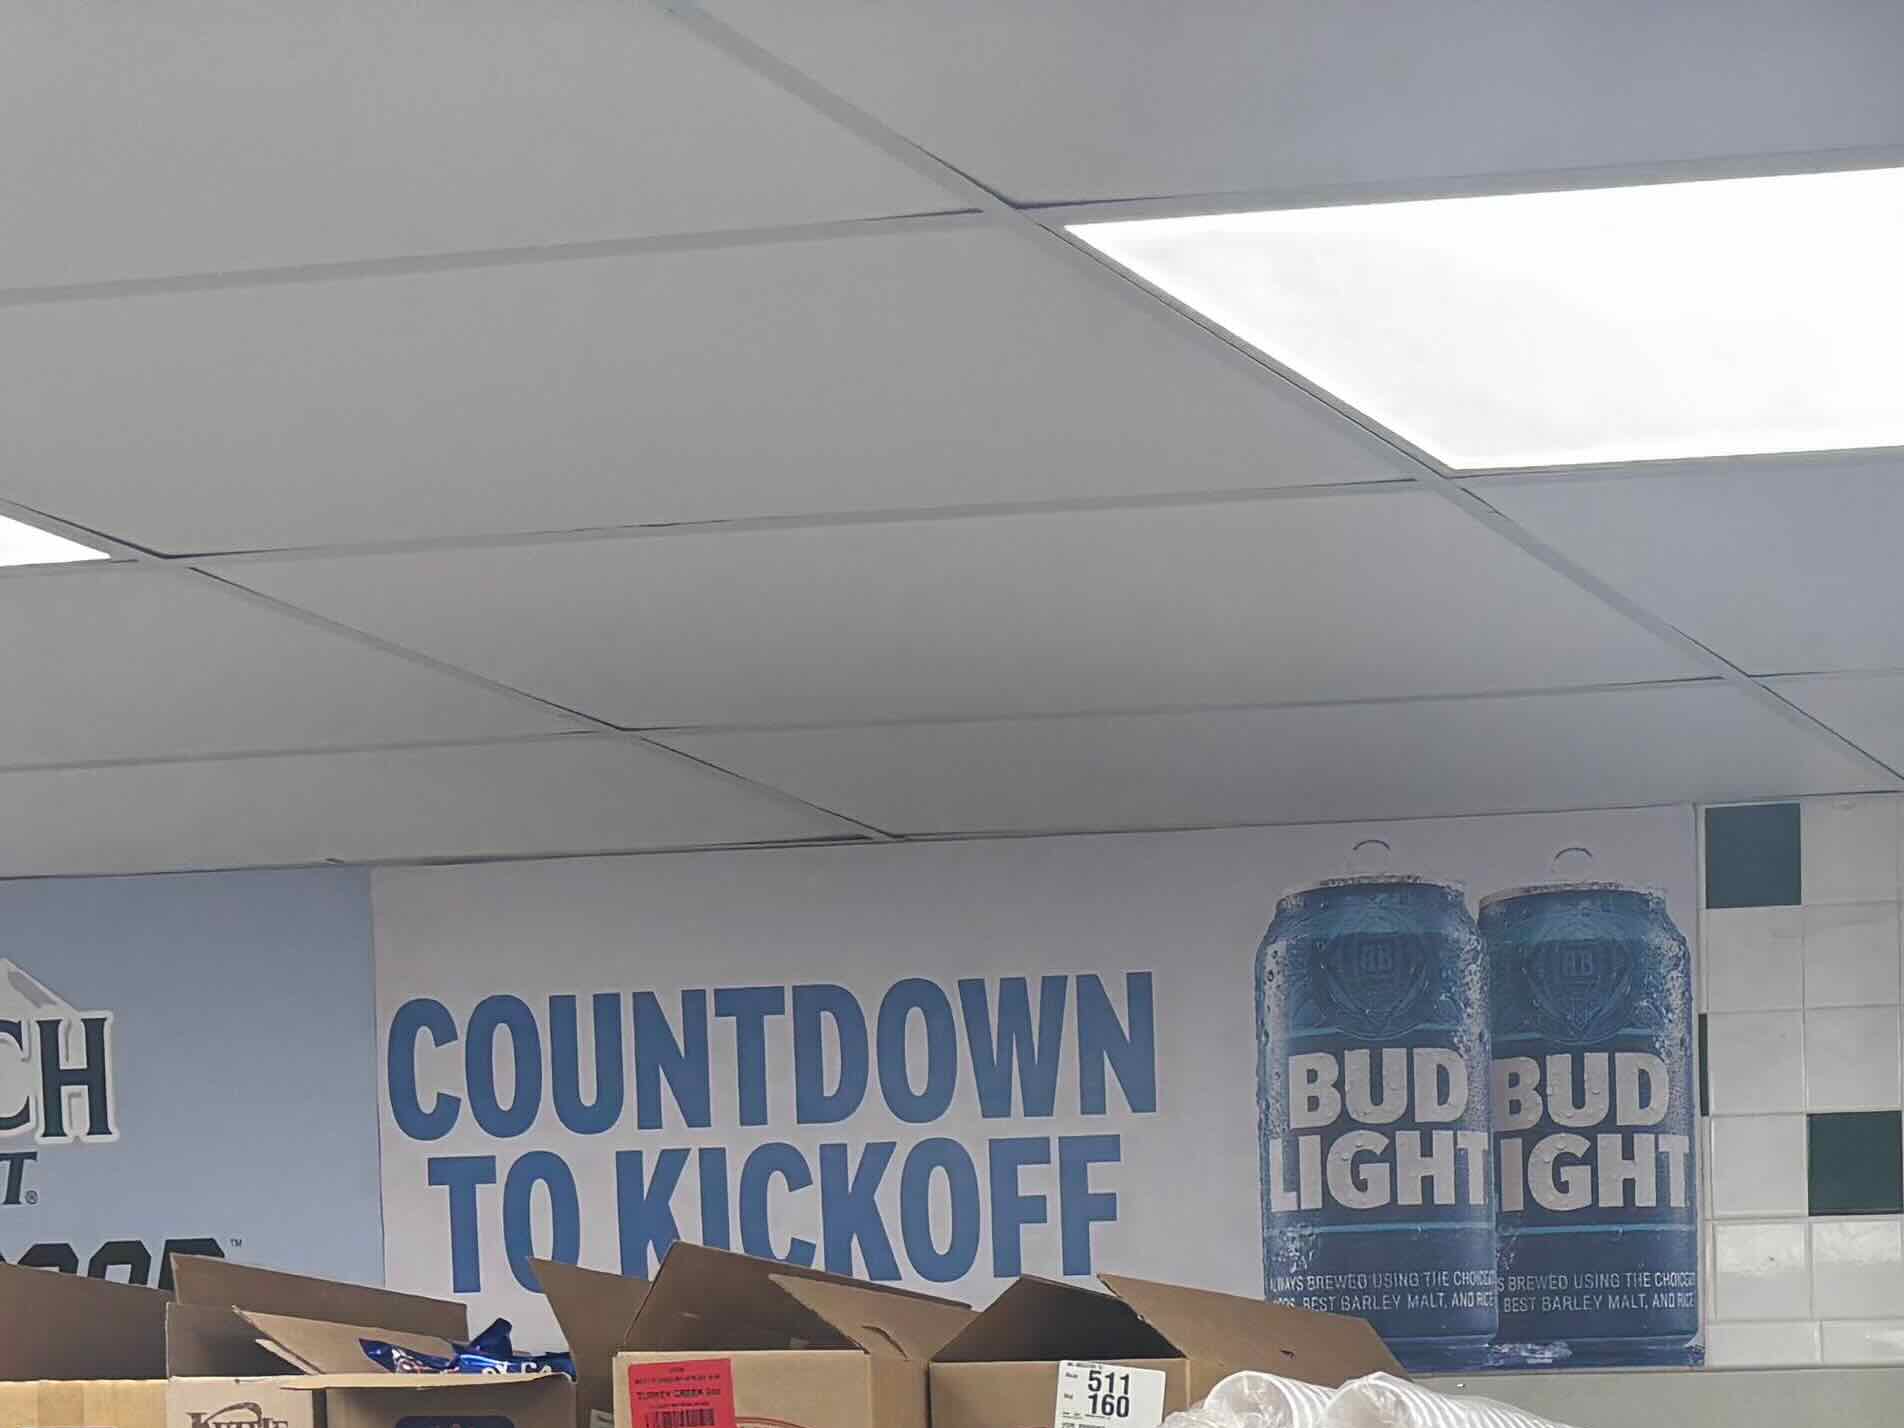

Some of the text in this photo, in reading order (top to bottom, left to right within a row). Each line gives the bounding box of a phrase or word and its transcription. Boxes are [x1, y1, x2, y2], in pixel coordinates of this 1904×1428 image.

[388, 972, 1156, 1140] COUNTDOWN
[1289, 1048, 1468, 1128] BUD
[1494, 1052, 1670, 1130] BUD
[1270, 1130, 1489, 1211] LIGHT
[428, 1150, 582, 1292] TO
[616, 1134, 1120, 1282] KICKOFF
[1341, 1293, 1448, 1310] BARLEY MALT,
[1373, 1272, 1449, 1290] USING THE
[1504, 1296, 1649, 1312] BEST BARLEY MALT,
[1508, 1273, 1651, 1291] BREWED USING THE
[1088, 1370, 1130, 1395] 511
[1088, 1393, 1130, 1418] 160
